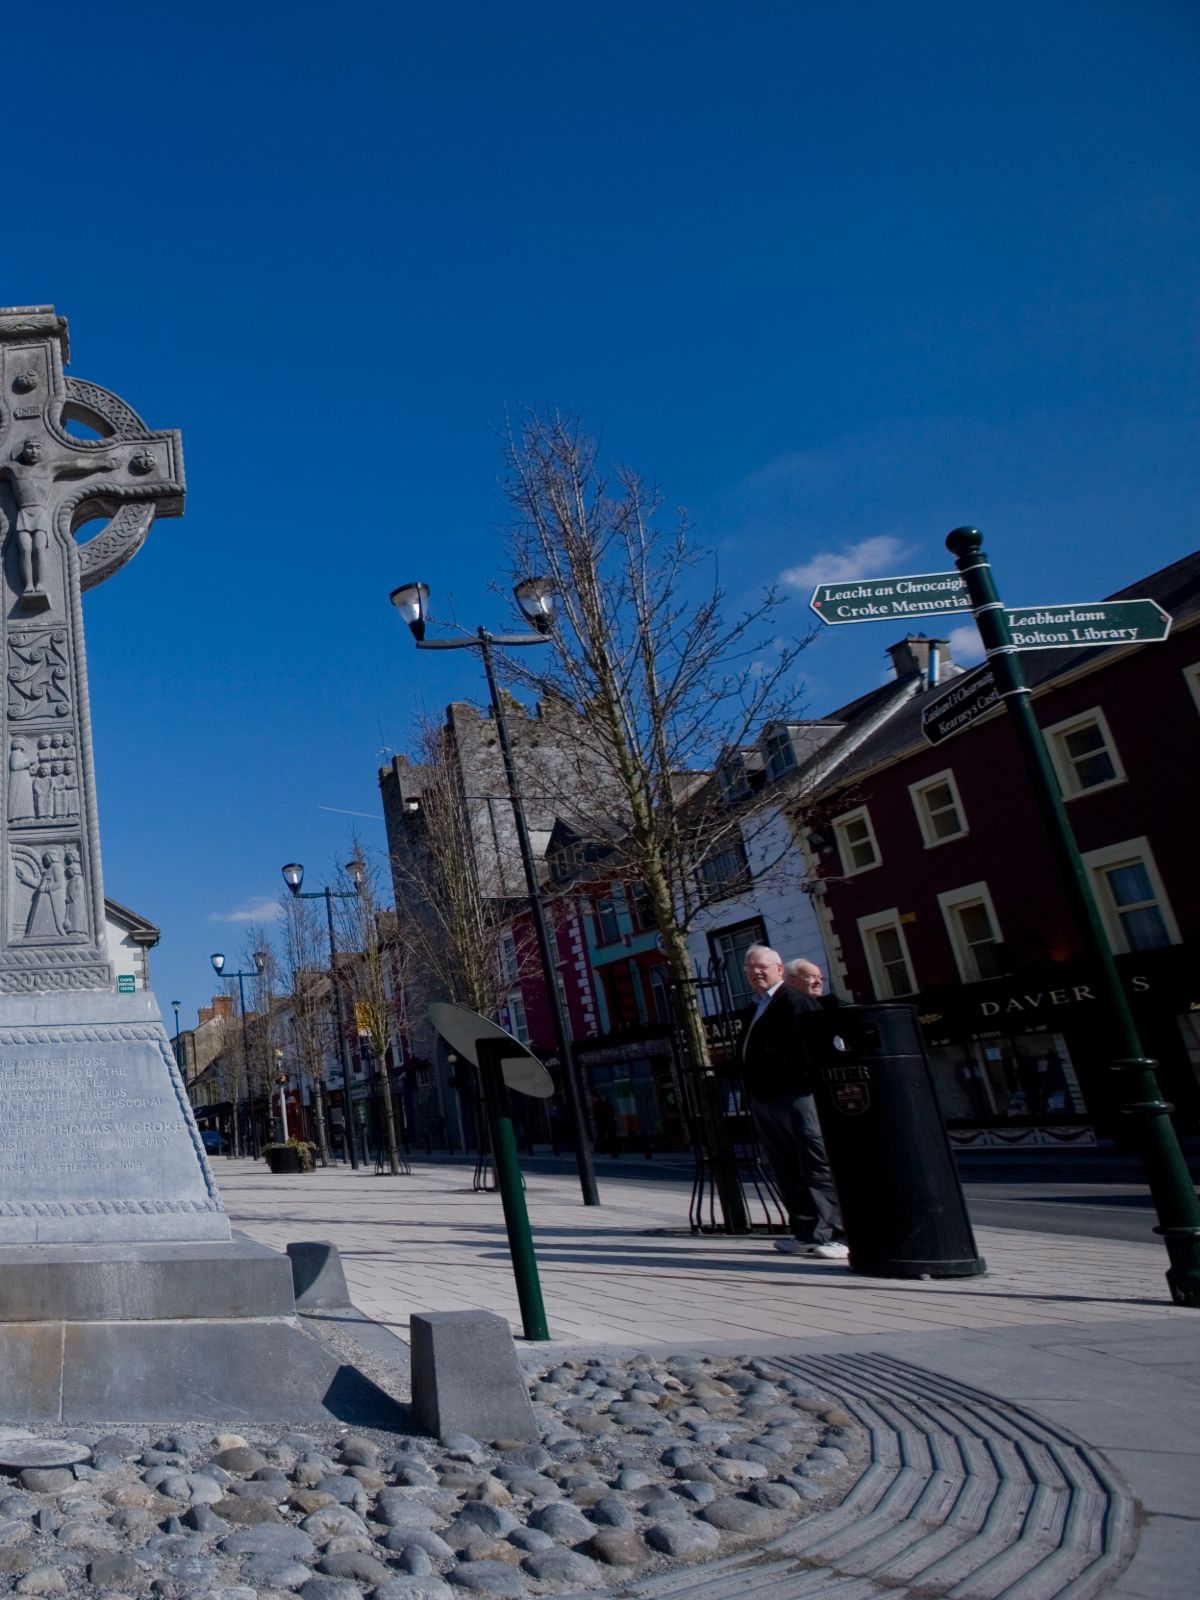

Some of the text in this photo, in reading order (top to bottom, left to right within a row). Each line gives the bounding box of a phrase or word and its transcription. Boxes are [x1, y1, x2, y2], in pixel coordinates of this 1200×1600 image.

[824, 586, 872, 602] Leacht
[875, 586, 894, 596] an
[837, 594, 972, 618] Croke Memorial
[1008, 610, 1106, 626] Leabharlann
[1010, 627, 1138, 645] Bolton Library
[978, 687, 1000, 708] Castl
[980, 976, 1150, 1017] DAVERS
[18, 1058, 64, 1070] MARKET
[68, 1057, 107, 1067] CROSS
[31, 1068, 83, 1079] ERECTED
[86, 1068, 100, 1077] BY
[104, 1067, 128, 1077] THE
[44, 1080, 59, 1089] OF
[63, 1079, 107, 1088] CASHEL
[0, 1092, 7, 1101] A
[10, 1092, 32, 1101] FEW
[36, 1090, 74, 1100] OTHER
[80, 1088, 128, 1098] FRIENDS
[33, 1102, 55, 1112] THE
[57, 1100, 96, 1111] SILVER
[100, 1098, 166, 1109] EPISCOPAL
[34, 1112, 49, 1122] OF
[54, 1111, 72, 1121] HIS
[76, 1110, 114, 1120] GRACE
[51, 1122, 112, 1135] THOMAS
[132, 1120, 182, 1134] CROKE
[42, 1140, 56, 1150] OF
[60, 1138, 105, 1150] CASHEL
[110, 1138, 136, 1148] AND
[138, 1136, 169, 1148] EMLY
[28, 1162, 55, 1174] WAS
[58, 1161, 113, 1172] ERECTED
